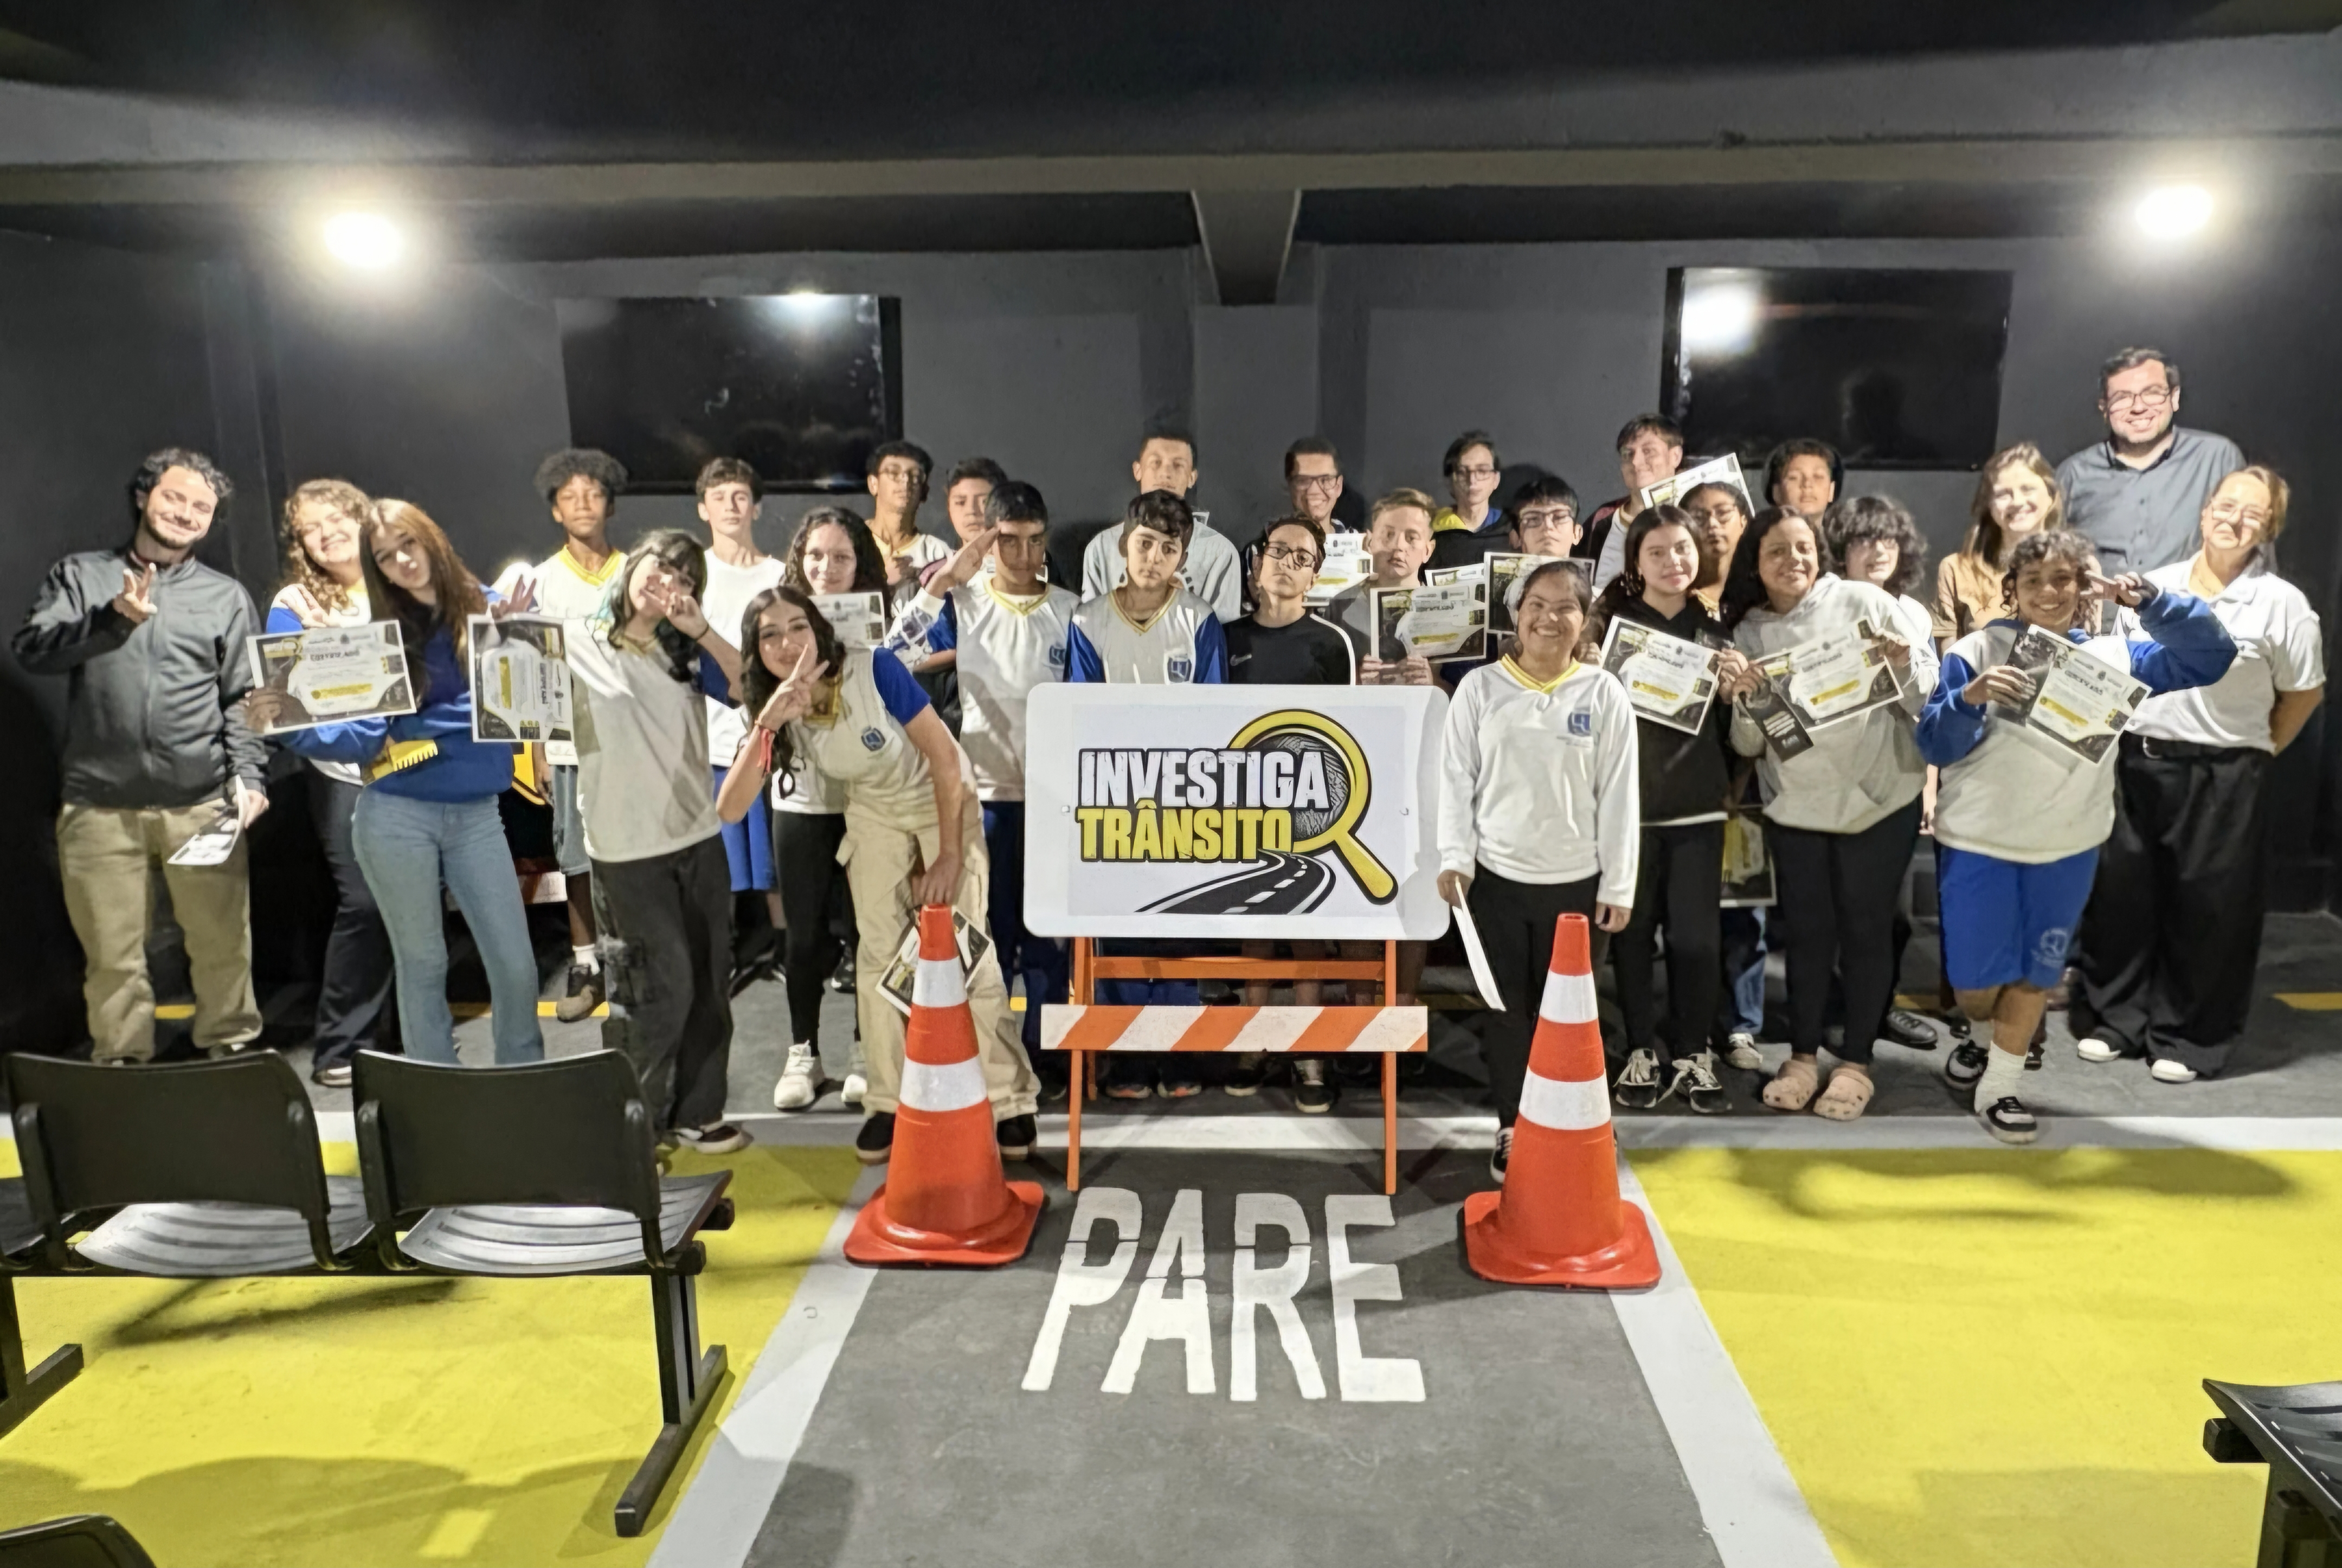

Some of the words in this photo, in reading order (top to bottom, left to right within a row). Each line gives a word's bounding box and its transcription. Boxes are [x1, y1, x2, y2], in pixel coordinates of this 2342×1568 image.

[1079, 749, 1331, 809] INVESTIGA
[1077, 800, 1292, 861] TRÂNSITO
[1021, 1186, 1426, 1402] PARE
